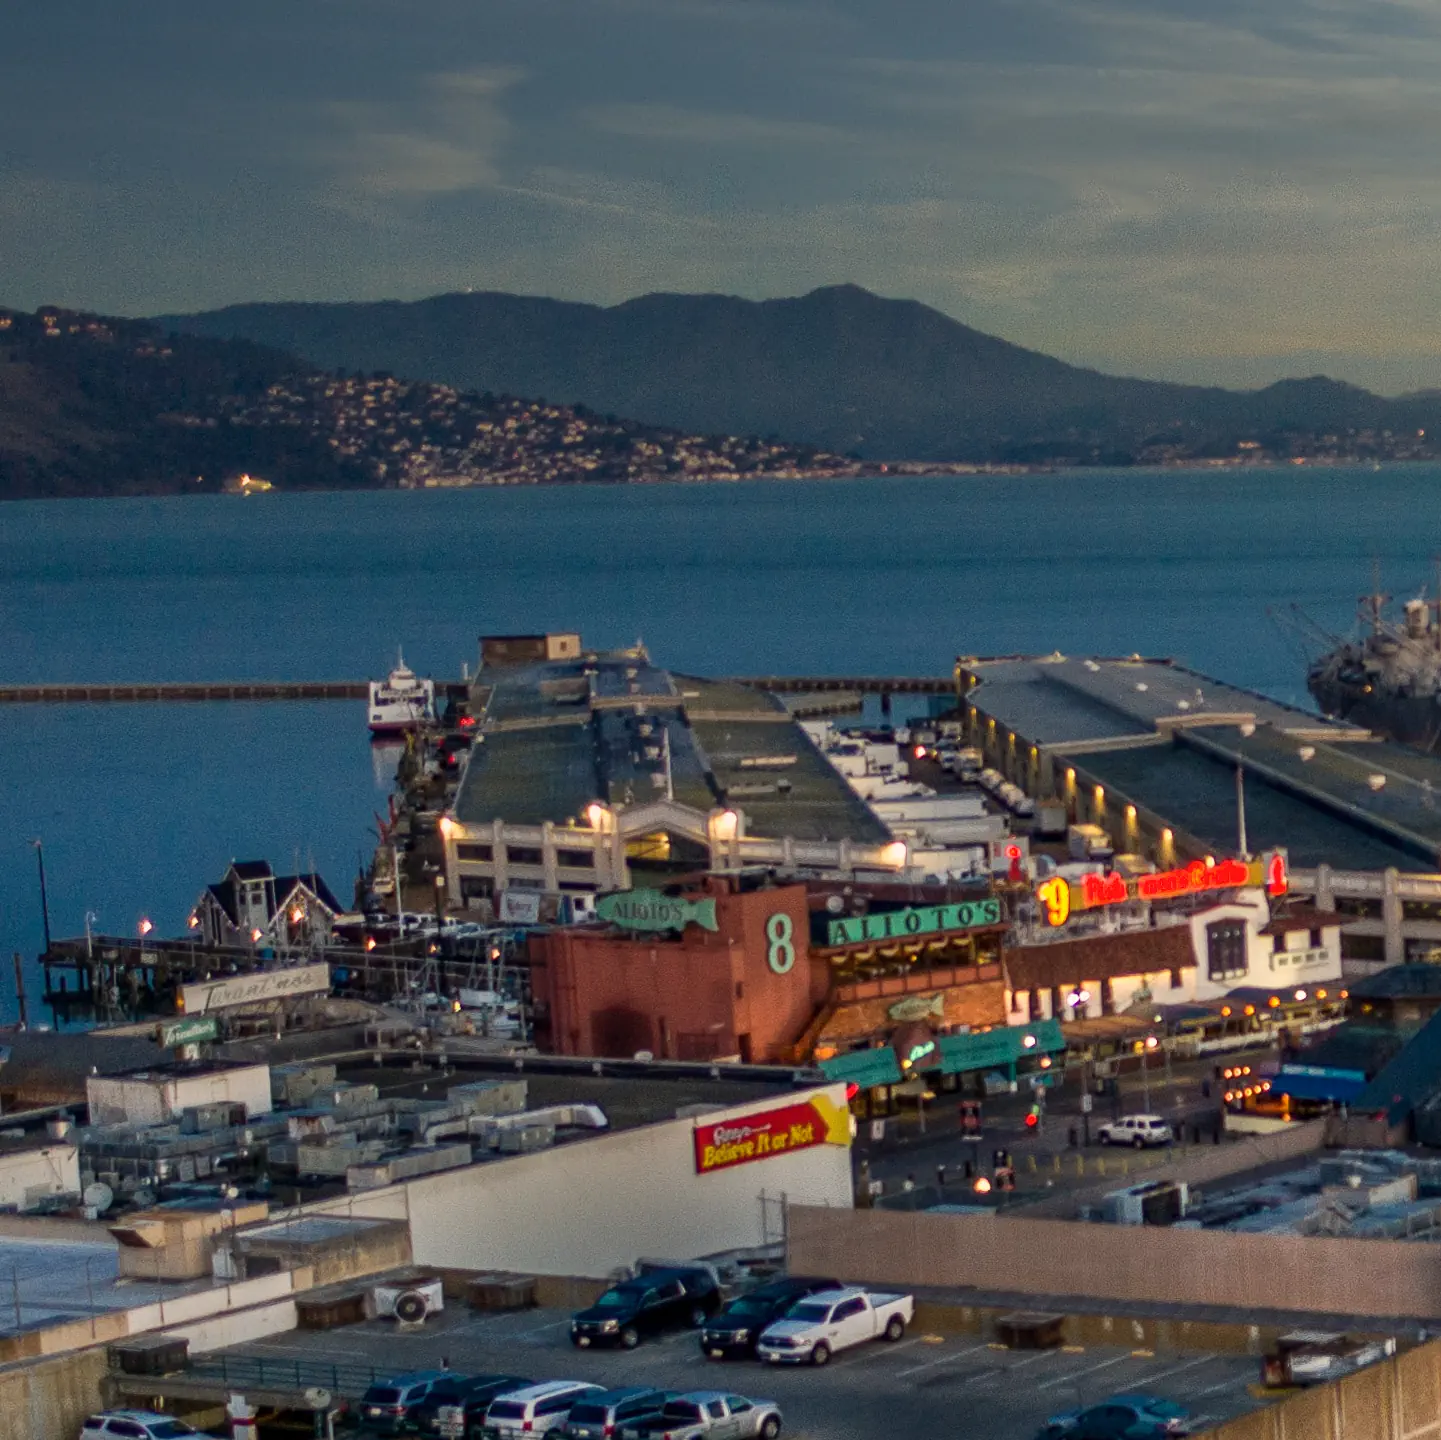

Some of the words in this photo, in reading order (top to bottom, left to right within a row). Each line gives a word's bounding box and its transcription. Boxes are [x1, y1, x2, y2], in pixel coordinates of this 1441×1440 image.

[611, 900, 684, 922] ALIOTO'S
[1041, 877, 1069, 926] 9
[833, 902, 999, 943] ALIOTO'S
[767, 913, 796, 974] 8
[703, 1140, 754, 1168] Believe
[772, 1131, 788, 1149] or
